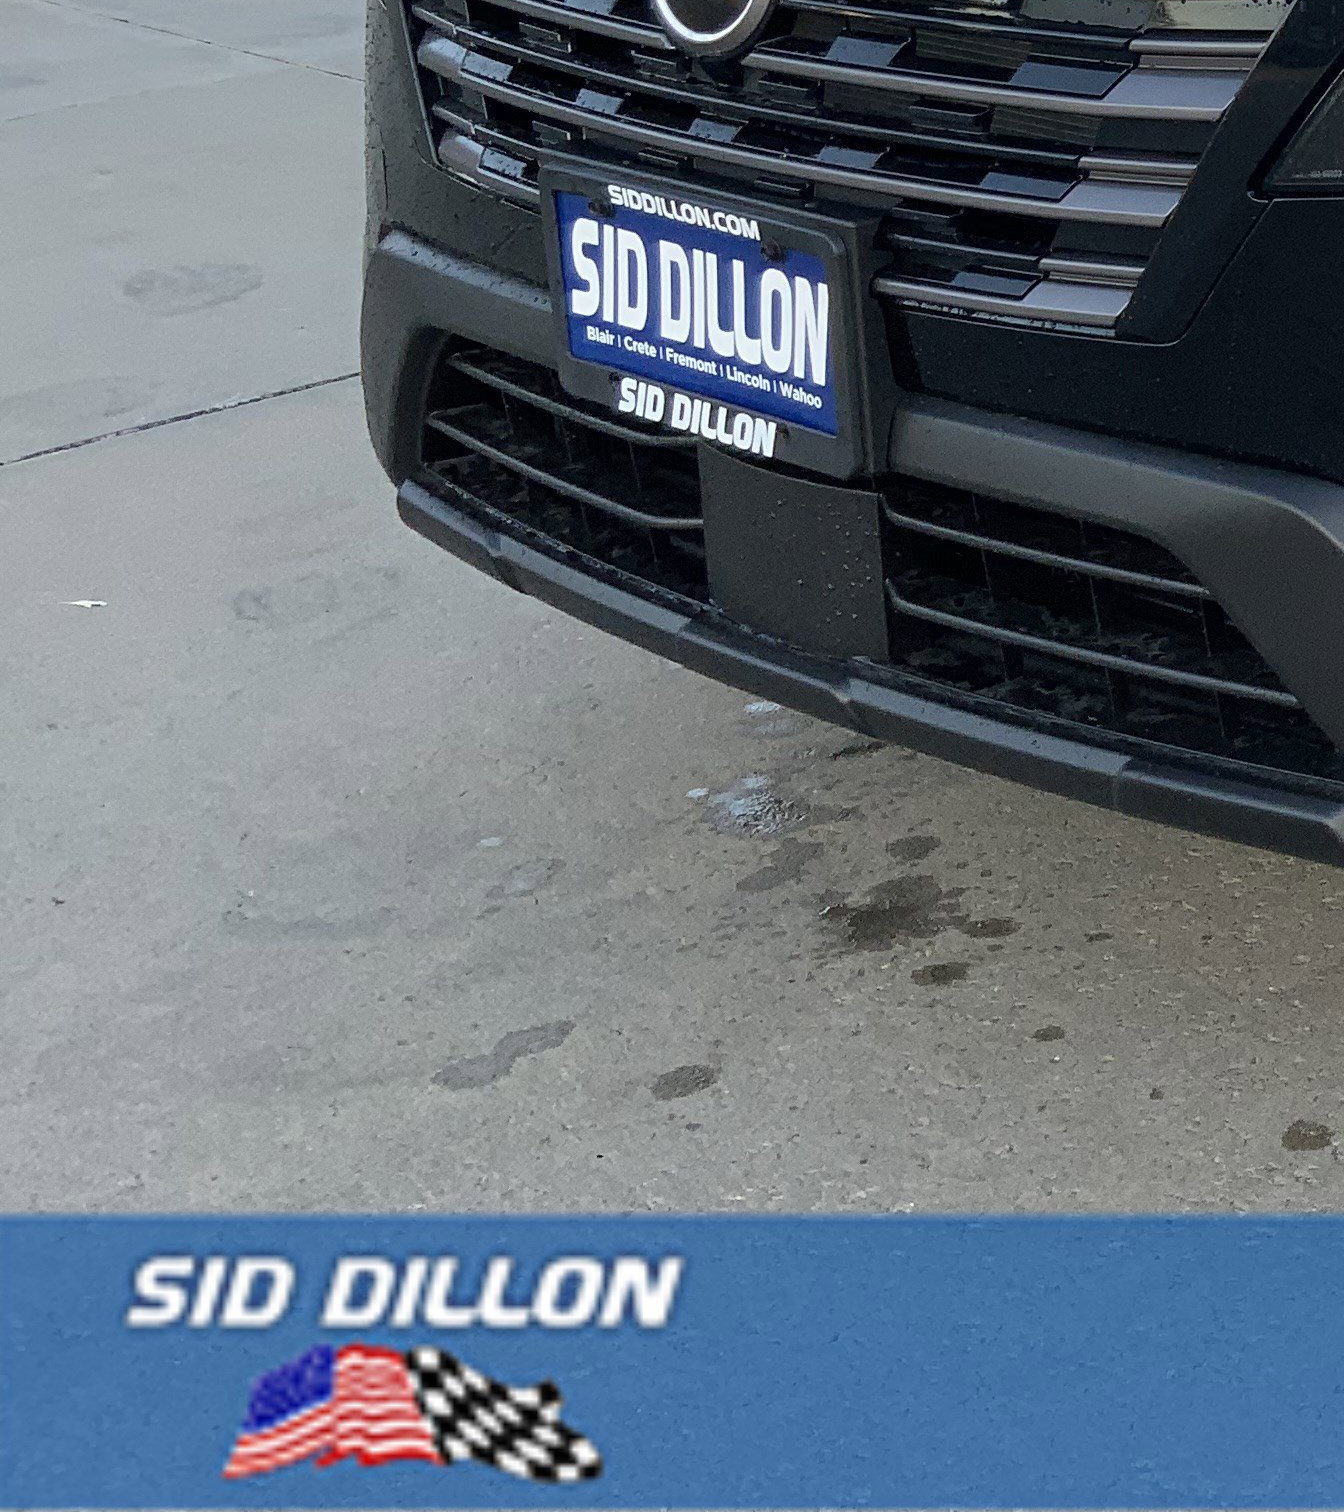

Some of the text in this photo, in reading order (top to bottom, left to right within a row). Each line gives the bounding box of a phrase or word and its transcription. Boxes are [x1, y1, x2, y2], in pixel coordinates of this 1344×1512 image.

[607, 184, 761, 241] SIDDILLON.COM
[571, 218, 829, 386] SID DILLON
[586, 325, 615, 346] Blair
[623, 336, 657, 358] Crete
[665, 348, 717, 376] Fremont
[726, 365, 770, 393] Lincoln
[779, 381, 823, 409] Wahoo
[618, 377, 777, 458] SID DILLON
